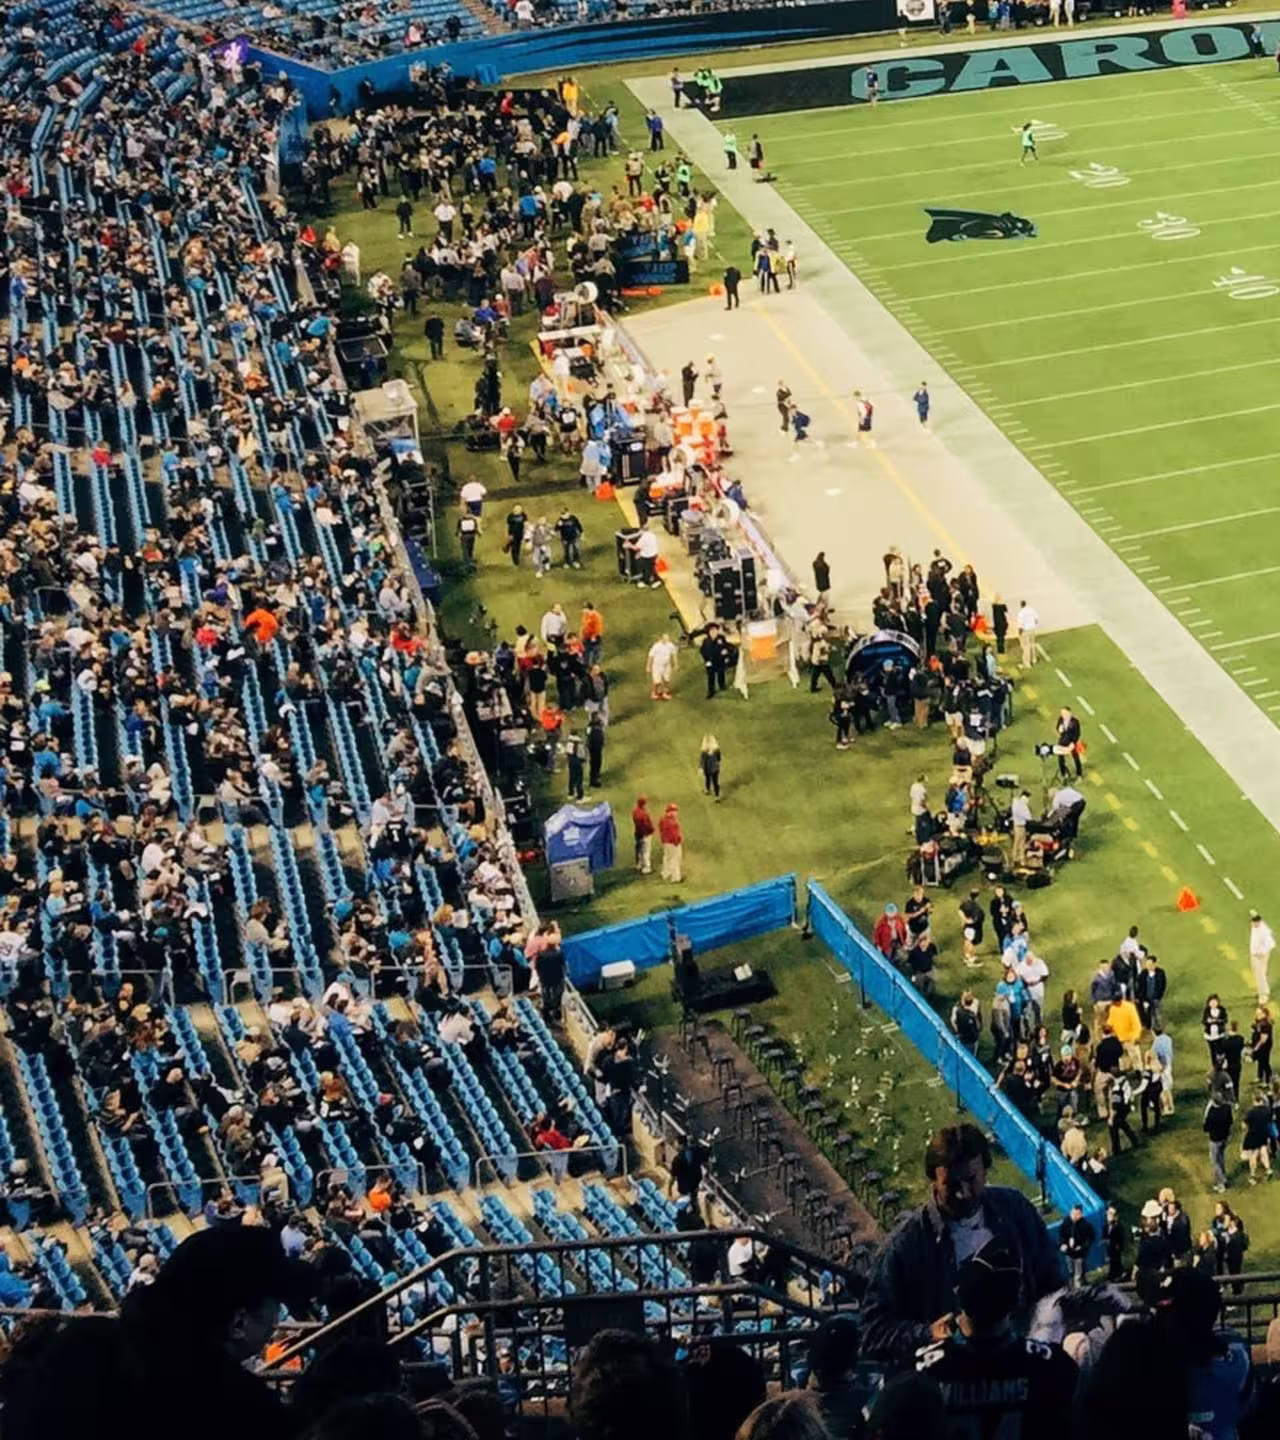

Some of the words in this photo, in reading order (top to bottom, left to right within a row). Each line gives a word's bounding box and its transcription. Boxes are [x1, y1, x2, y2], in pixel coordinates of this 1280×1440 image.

[1069, 162, 1132, 189] 20
[1137, 213, 1201, 241] 30
[1212, 273, 1280, 300] 40
[938, 1377, 1030, 1407] WILLIAMS
